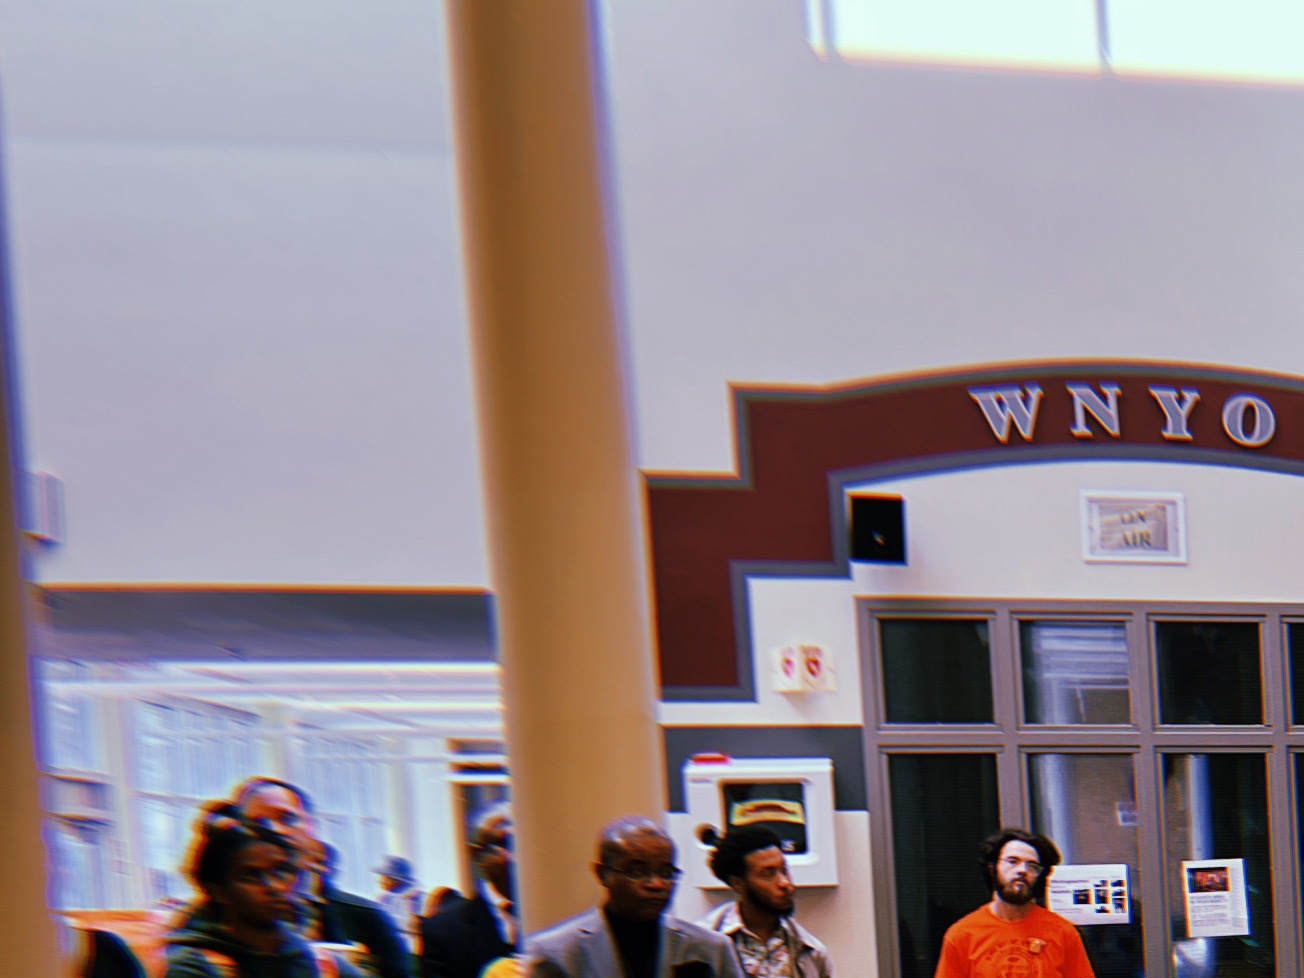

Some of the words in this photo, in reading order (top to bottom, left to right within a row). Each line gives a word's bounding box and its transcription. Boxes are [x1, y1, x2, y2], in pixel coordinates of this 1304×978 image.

[967, 380, 1277, 448] WNYO
[1120, 508, 1147, 525] ON
[1119, 529, 1152, 548] AIR
